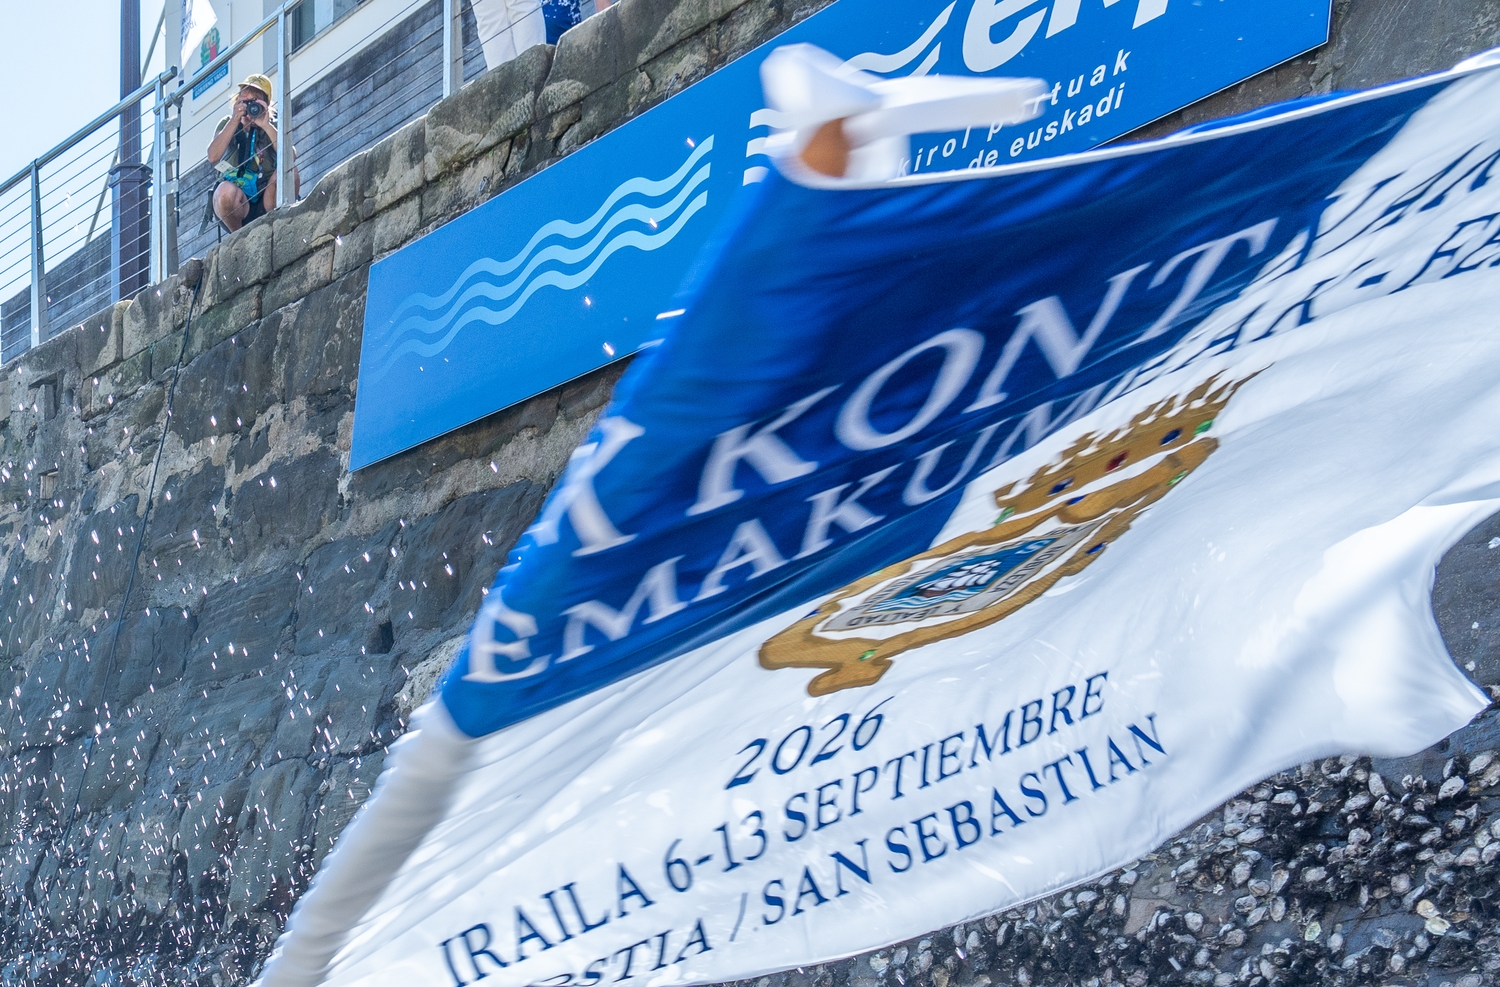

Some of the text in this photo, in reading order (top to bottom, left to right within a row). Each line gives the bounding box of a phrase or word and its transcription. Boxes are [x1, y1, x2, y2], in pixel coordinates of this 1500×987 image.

[1009, 82, 1126, 158] euskadi
[661, 811, 769, 893] 6-13
[781, 671, 1110, 843] SEPTIEMBRE
[725, 696, 895, 789] 2026
[761, 840, 872, 926] SAN
[885, 712, 1168, 874] SEBASTIAN
